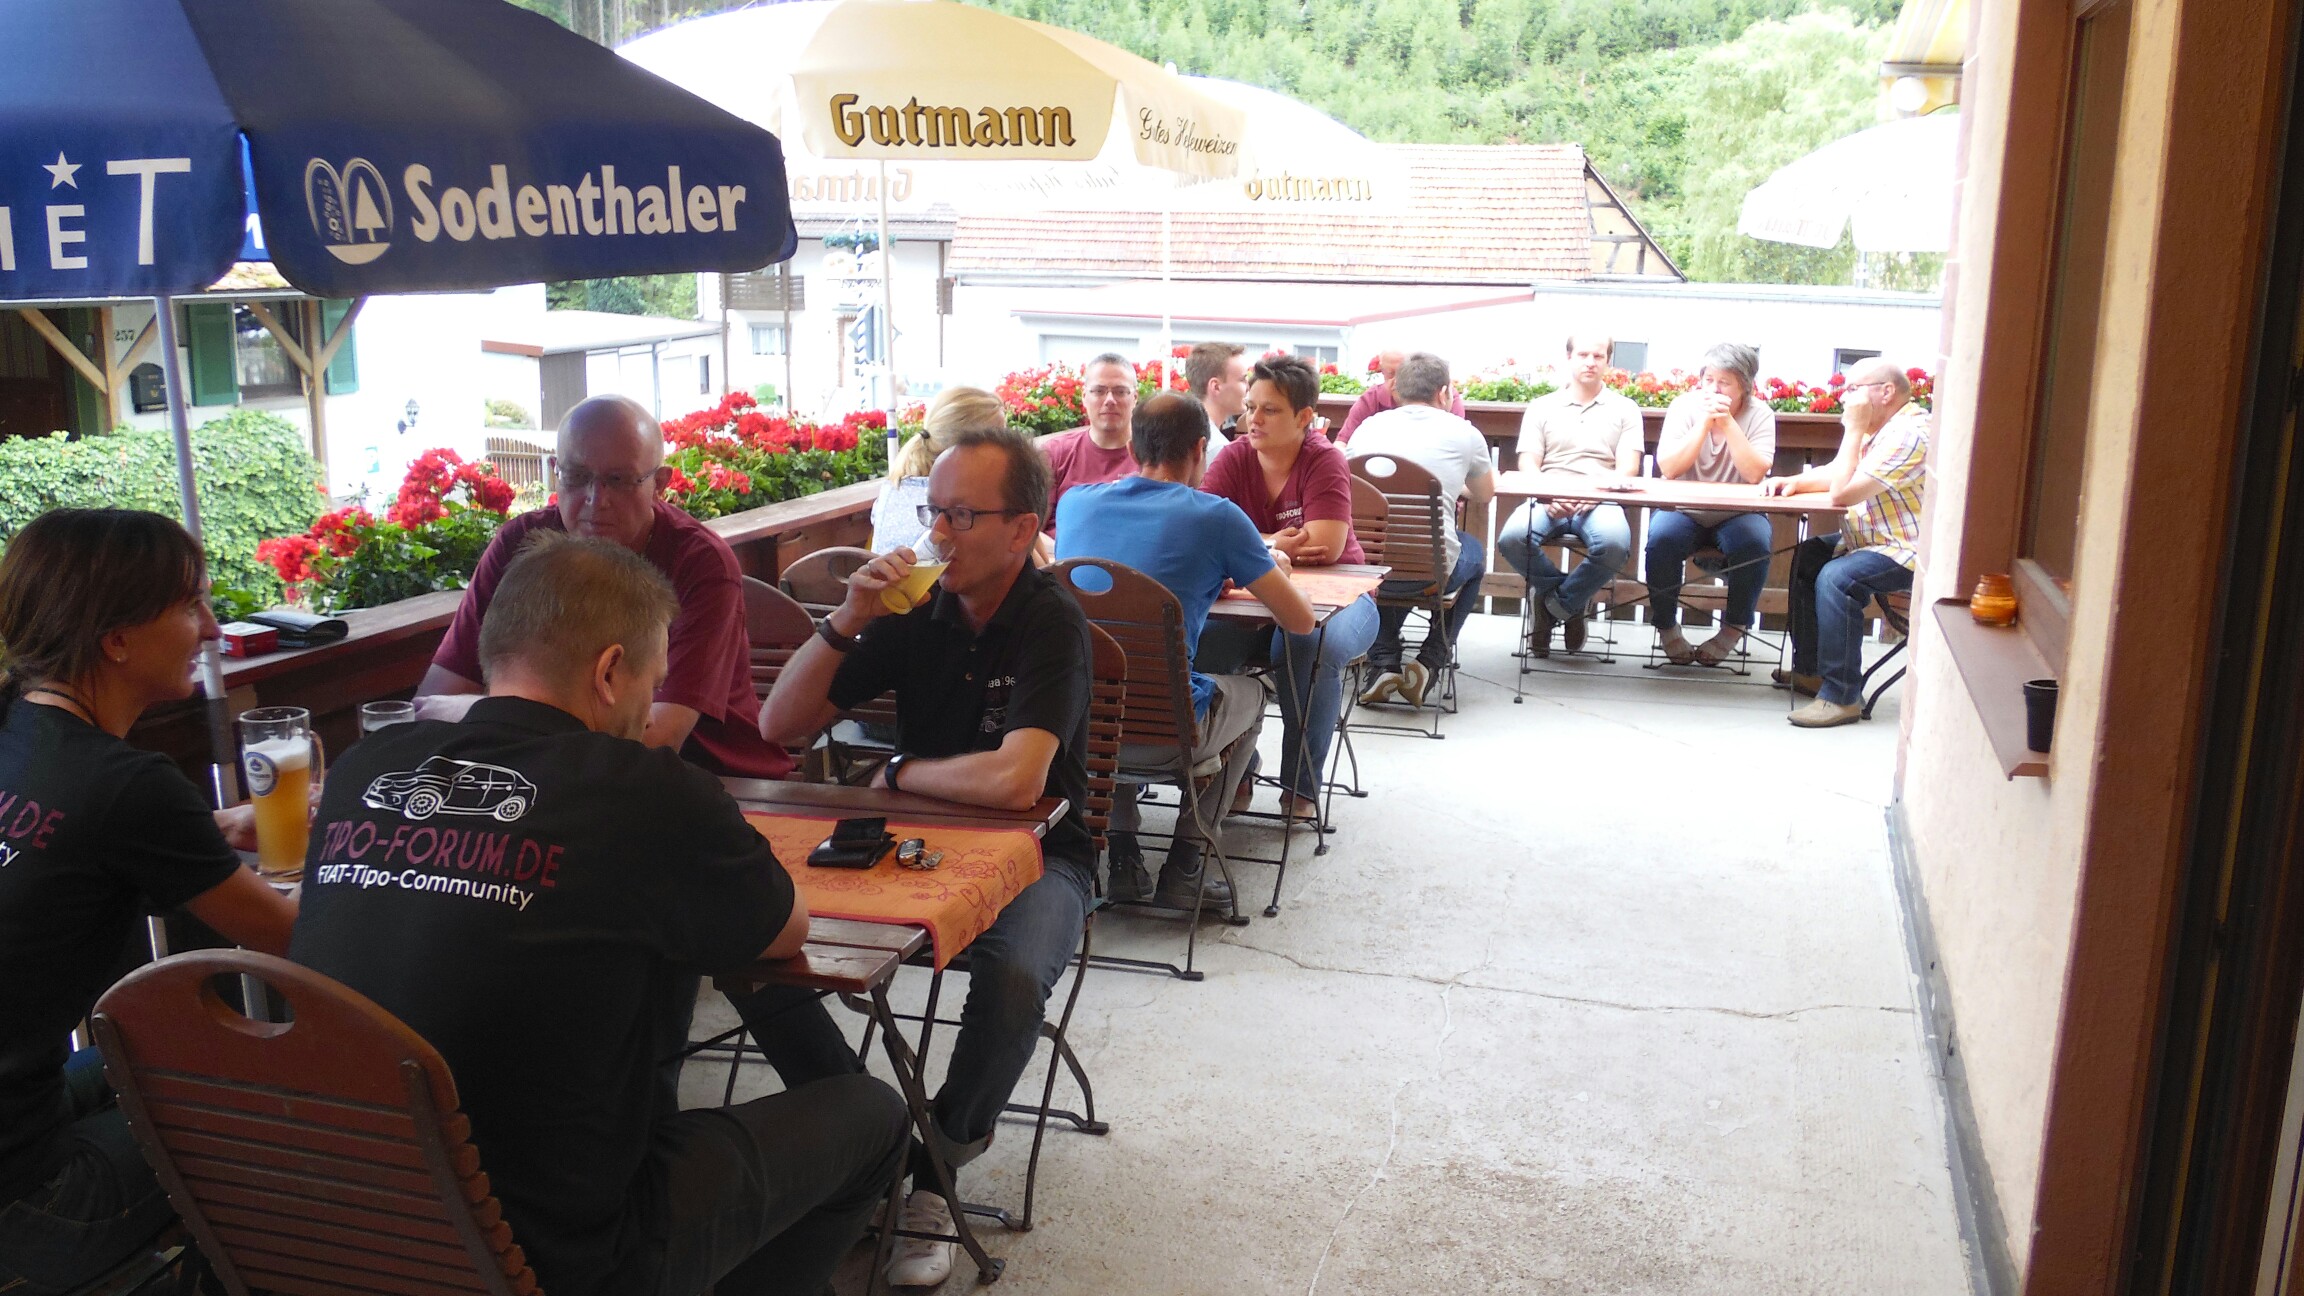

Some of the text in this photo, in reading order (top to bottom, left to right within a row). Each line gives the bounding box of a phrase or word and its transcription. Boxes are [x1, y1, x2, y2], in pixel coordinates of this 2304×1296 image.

[829, 93, 1077, 148] Gutmann
[403, 163, 747, 243] Sodenthaler
[319, 820, 565, 888] TIPO-FORUM.DE
[317, 864, 535, 912] FIAT-Tipo-Community
